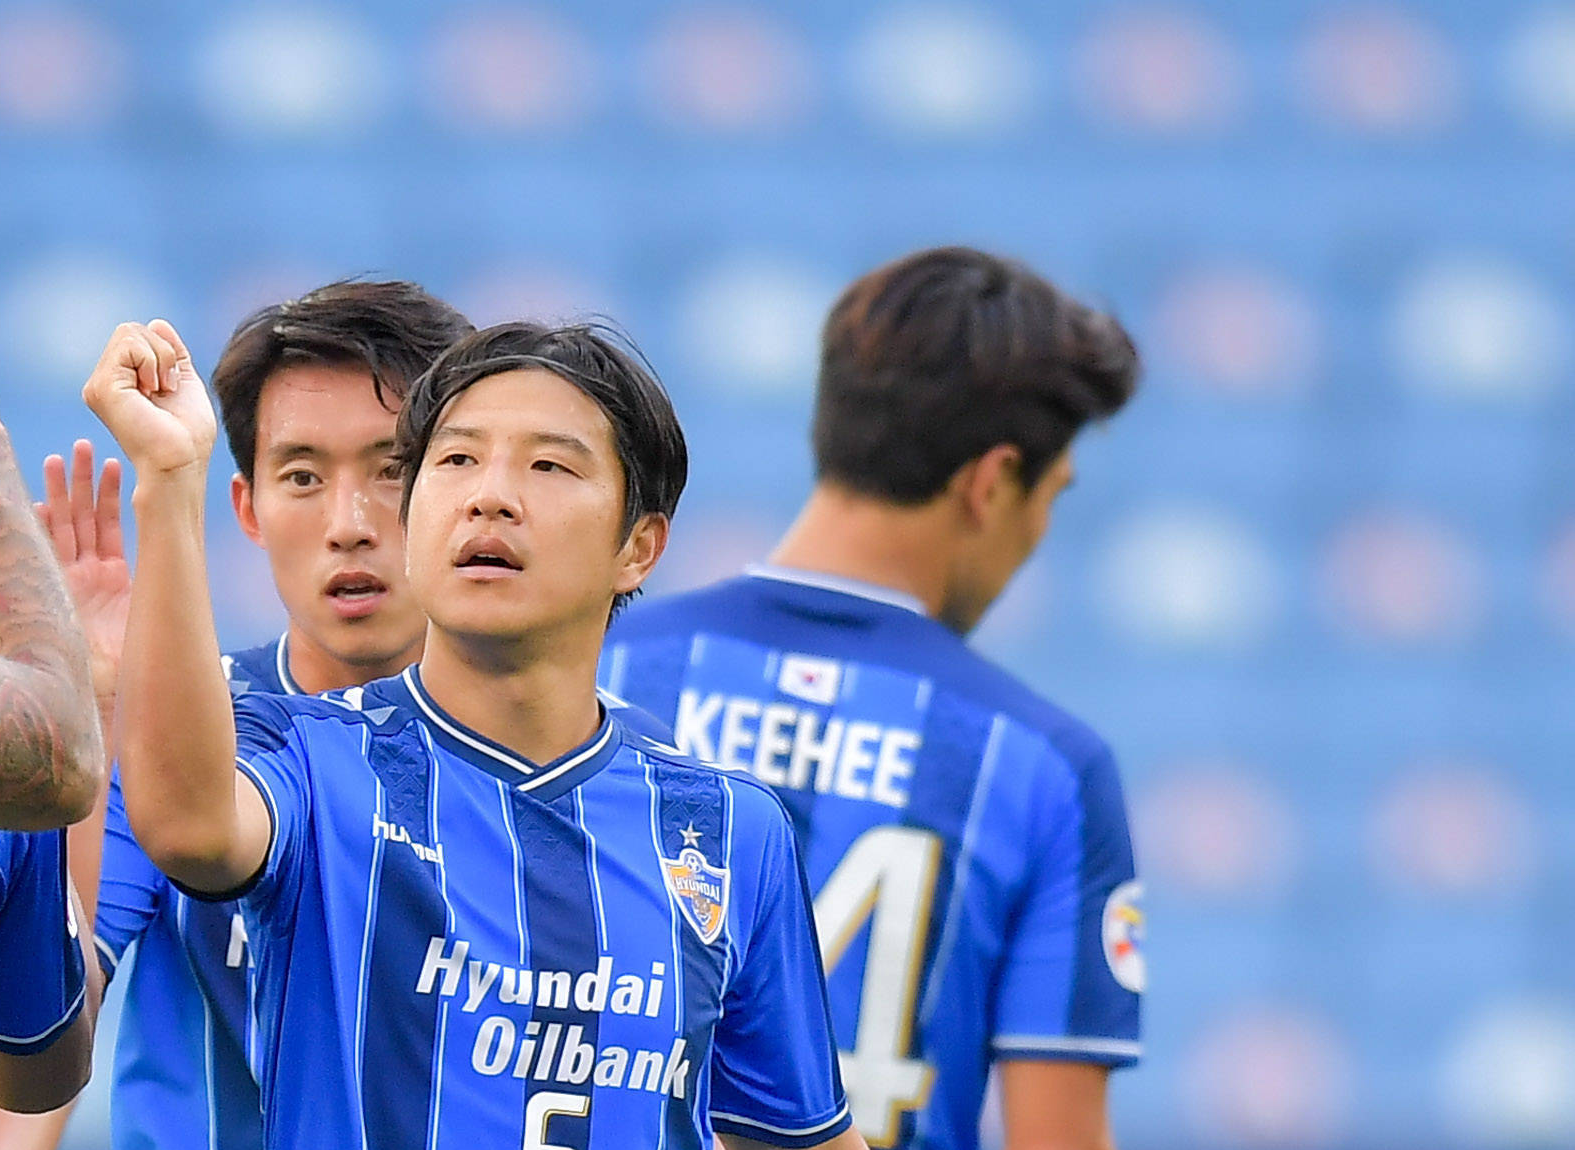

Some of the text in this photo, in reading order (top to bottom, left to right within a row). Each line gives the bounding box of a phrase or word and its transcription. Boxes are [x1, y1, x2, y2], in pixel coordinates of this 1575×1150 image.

[674, 688, 922, 808] KEEHEE
[415, 936, 666, 1018] Hyundai
[471, 1015, 690, 1099] Oilbank
